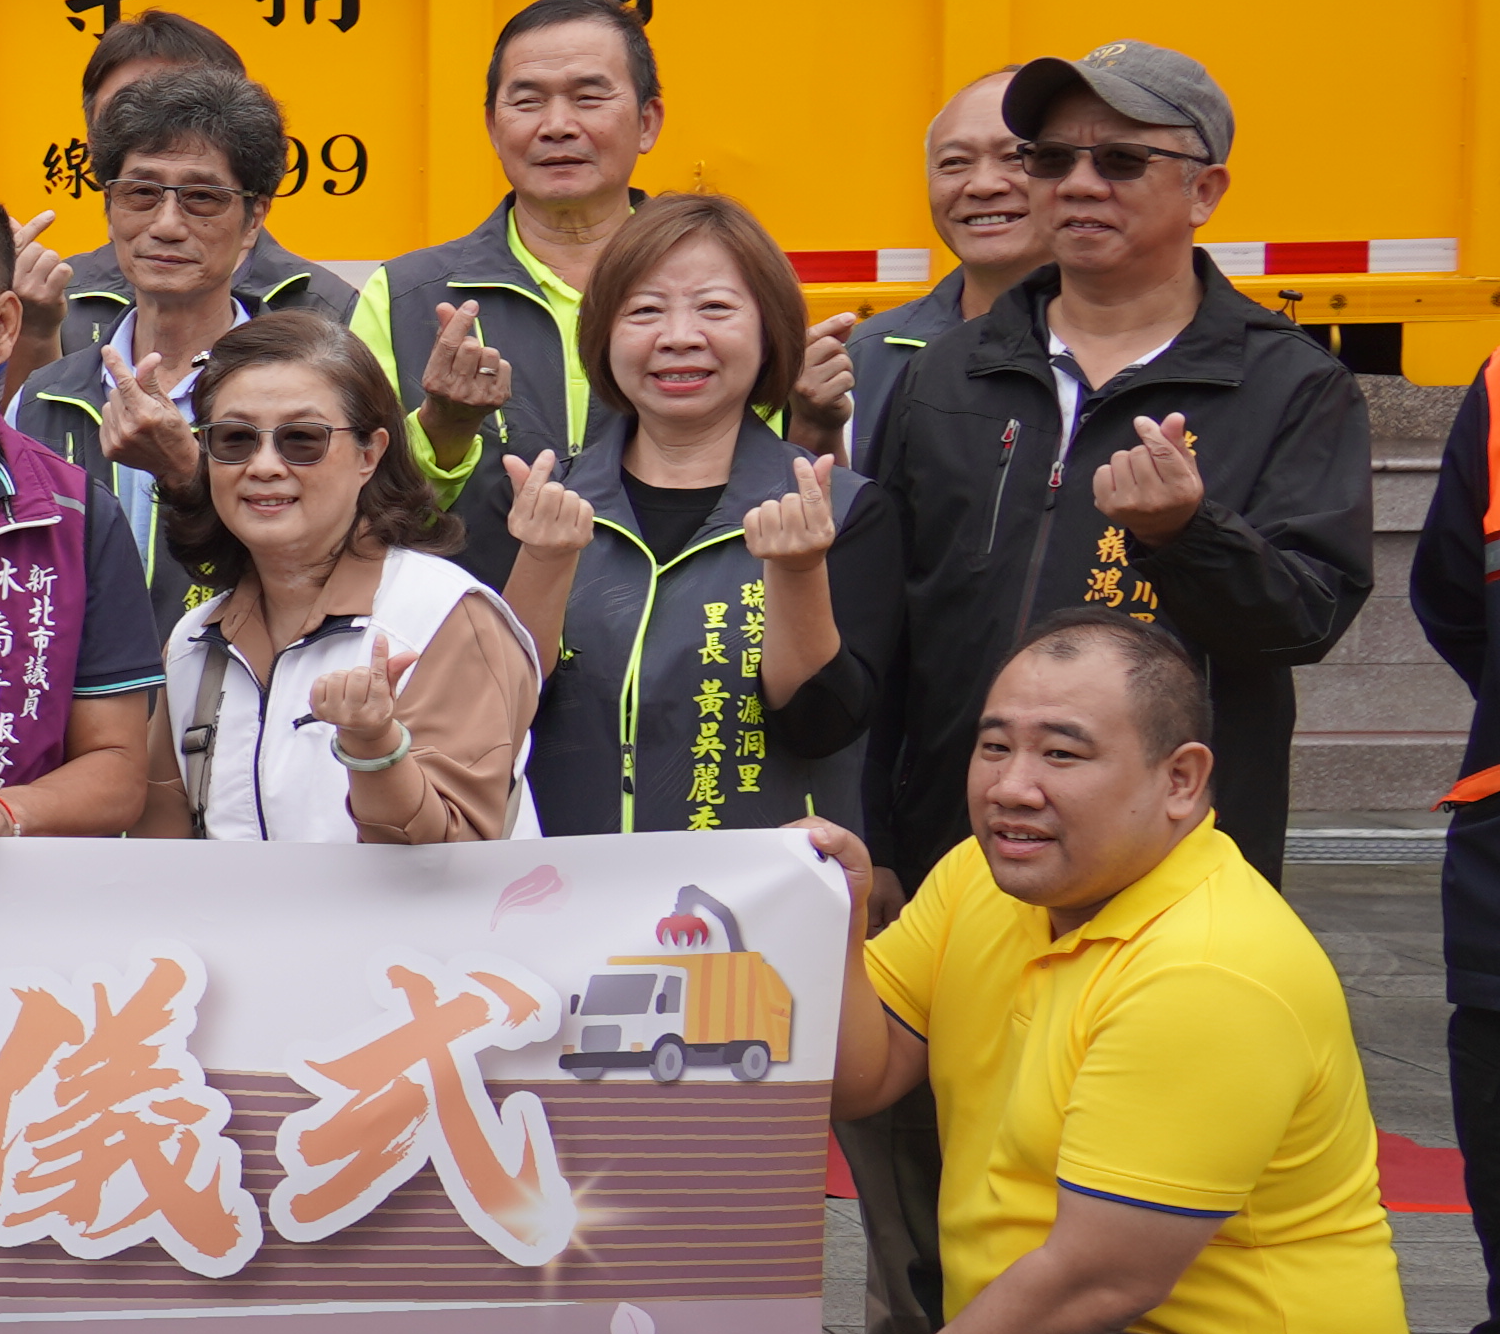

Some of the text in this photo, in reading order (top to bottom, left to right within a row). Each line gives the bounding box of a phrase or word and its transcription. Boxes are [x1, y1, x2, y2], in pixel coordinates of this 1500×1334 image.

[20, 563, 58, 720] 新北市議員
[698, 601, 730, 665] 里長
